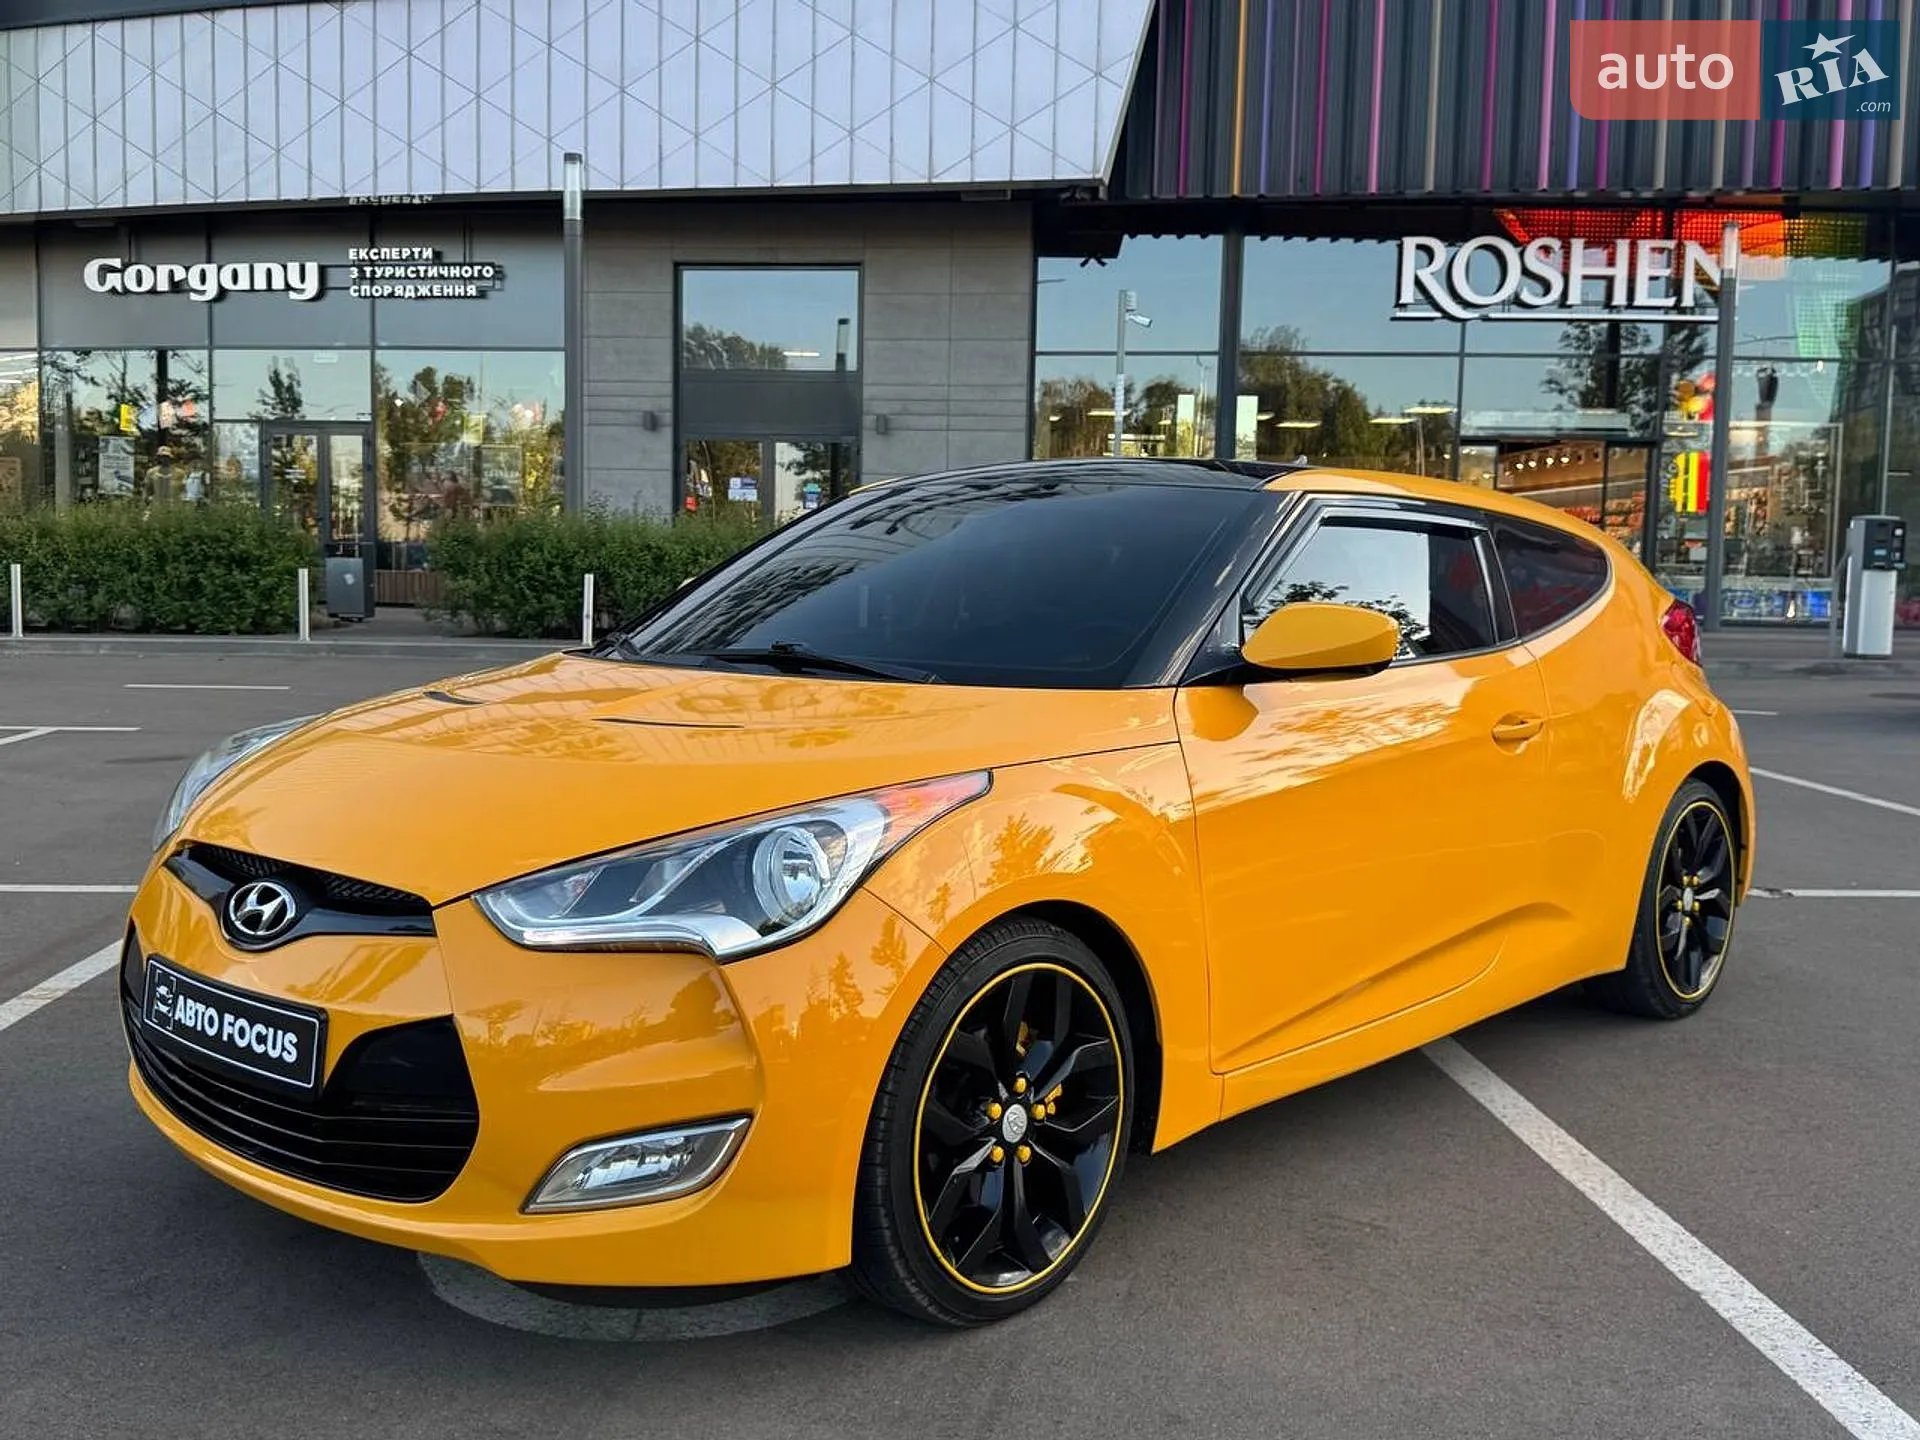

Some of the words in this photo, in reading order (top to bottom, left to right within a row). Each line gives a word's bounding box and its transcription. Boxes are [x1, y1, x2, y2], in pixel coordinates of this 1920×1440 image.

[348, 247, 433, 261] ЕКСПЕРТИ
[83, 257, 319, 302] Gorgany
[363, 265, 494, 279] ТУРИСТИЧНОГО
[1399, 235, 1721, 320] ROSHEN
[349, 284, 477, 299] СПОРЯДЖЕННЯ
[174, 994, 219, 1037] АВТО
[221, 1012, 298, 1064] FOCUS
